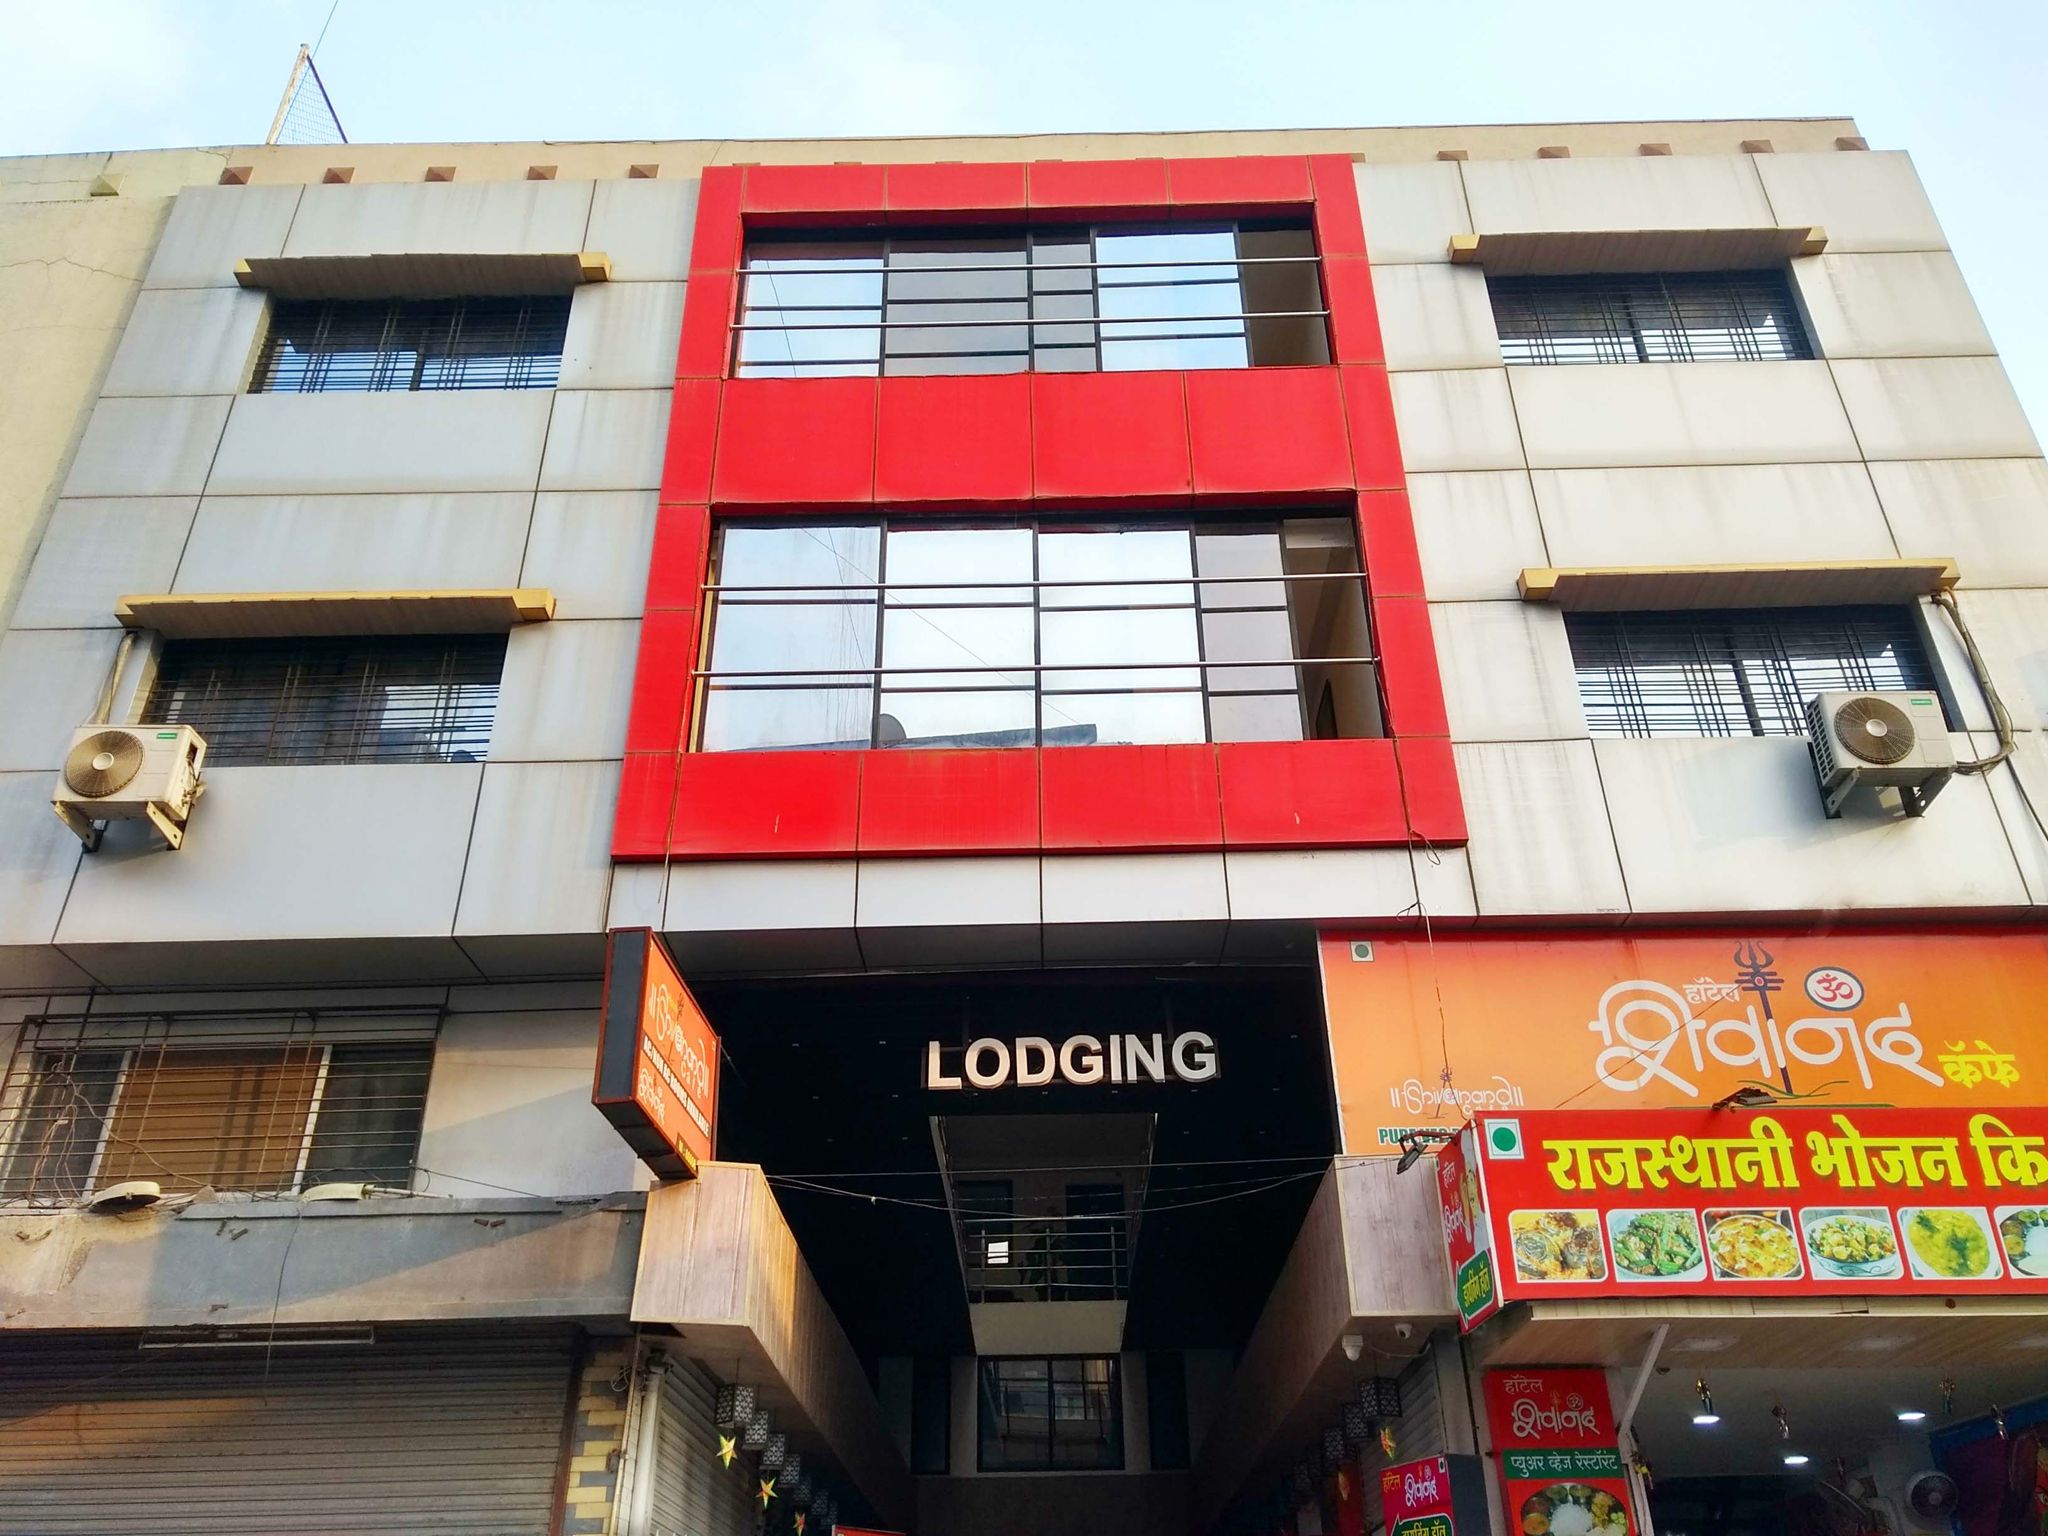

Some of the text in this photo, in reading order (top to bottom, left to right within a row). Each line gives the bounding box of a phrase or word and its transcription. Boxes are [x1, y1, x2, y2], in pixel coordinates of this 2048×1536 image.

[1682, 976, 1740, 1003] हॉटेल
[928, 1031, 1217, 1090] LODGING
[687, 1097, 710, 1138] AVAILABLE
[1542, 1116, 1800, 1190] राजस्थानी
[1806, 1114, 1969, 1188] भोजन
[1503, 1374, 1544, 1395] हॉटेल
[1510, 1455, 1545, 1478] प्युअर
[1547, 1451, 1572, 1472] व्हेज
